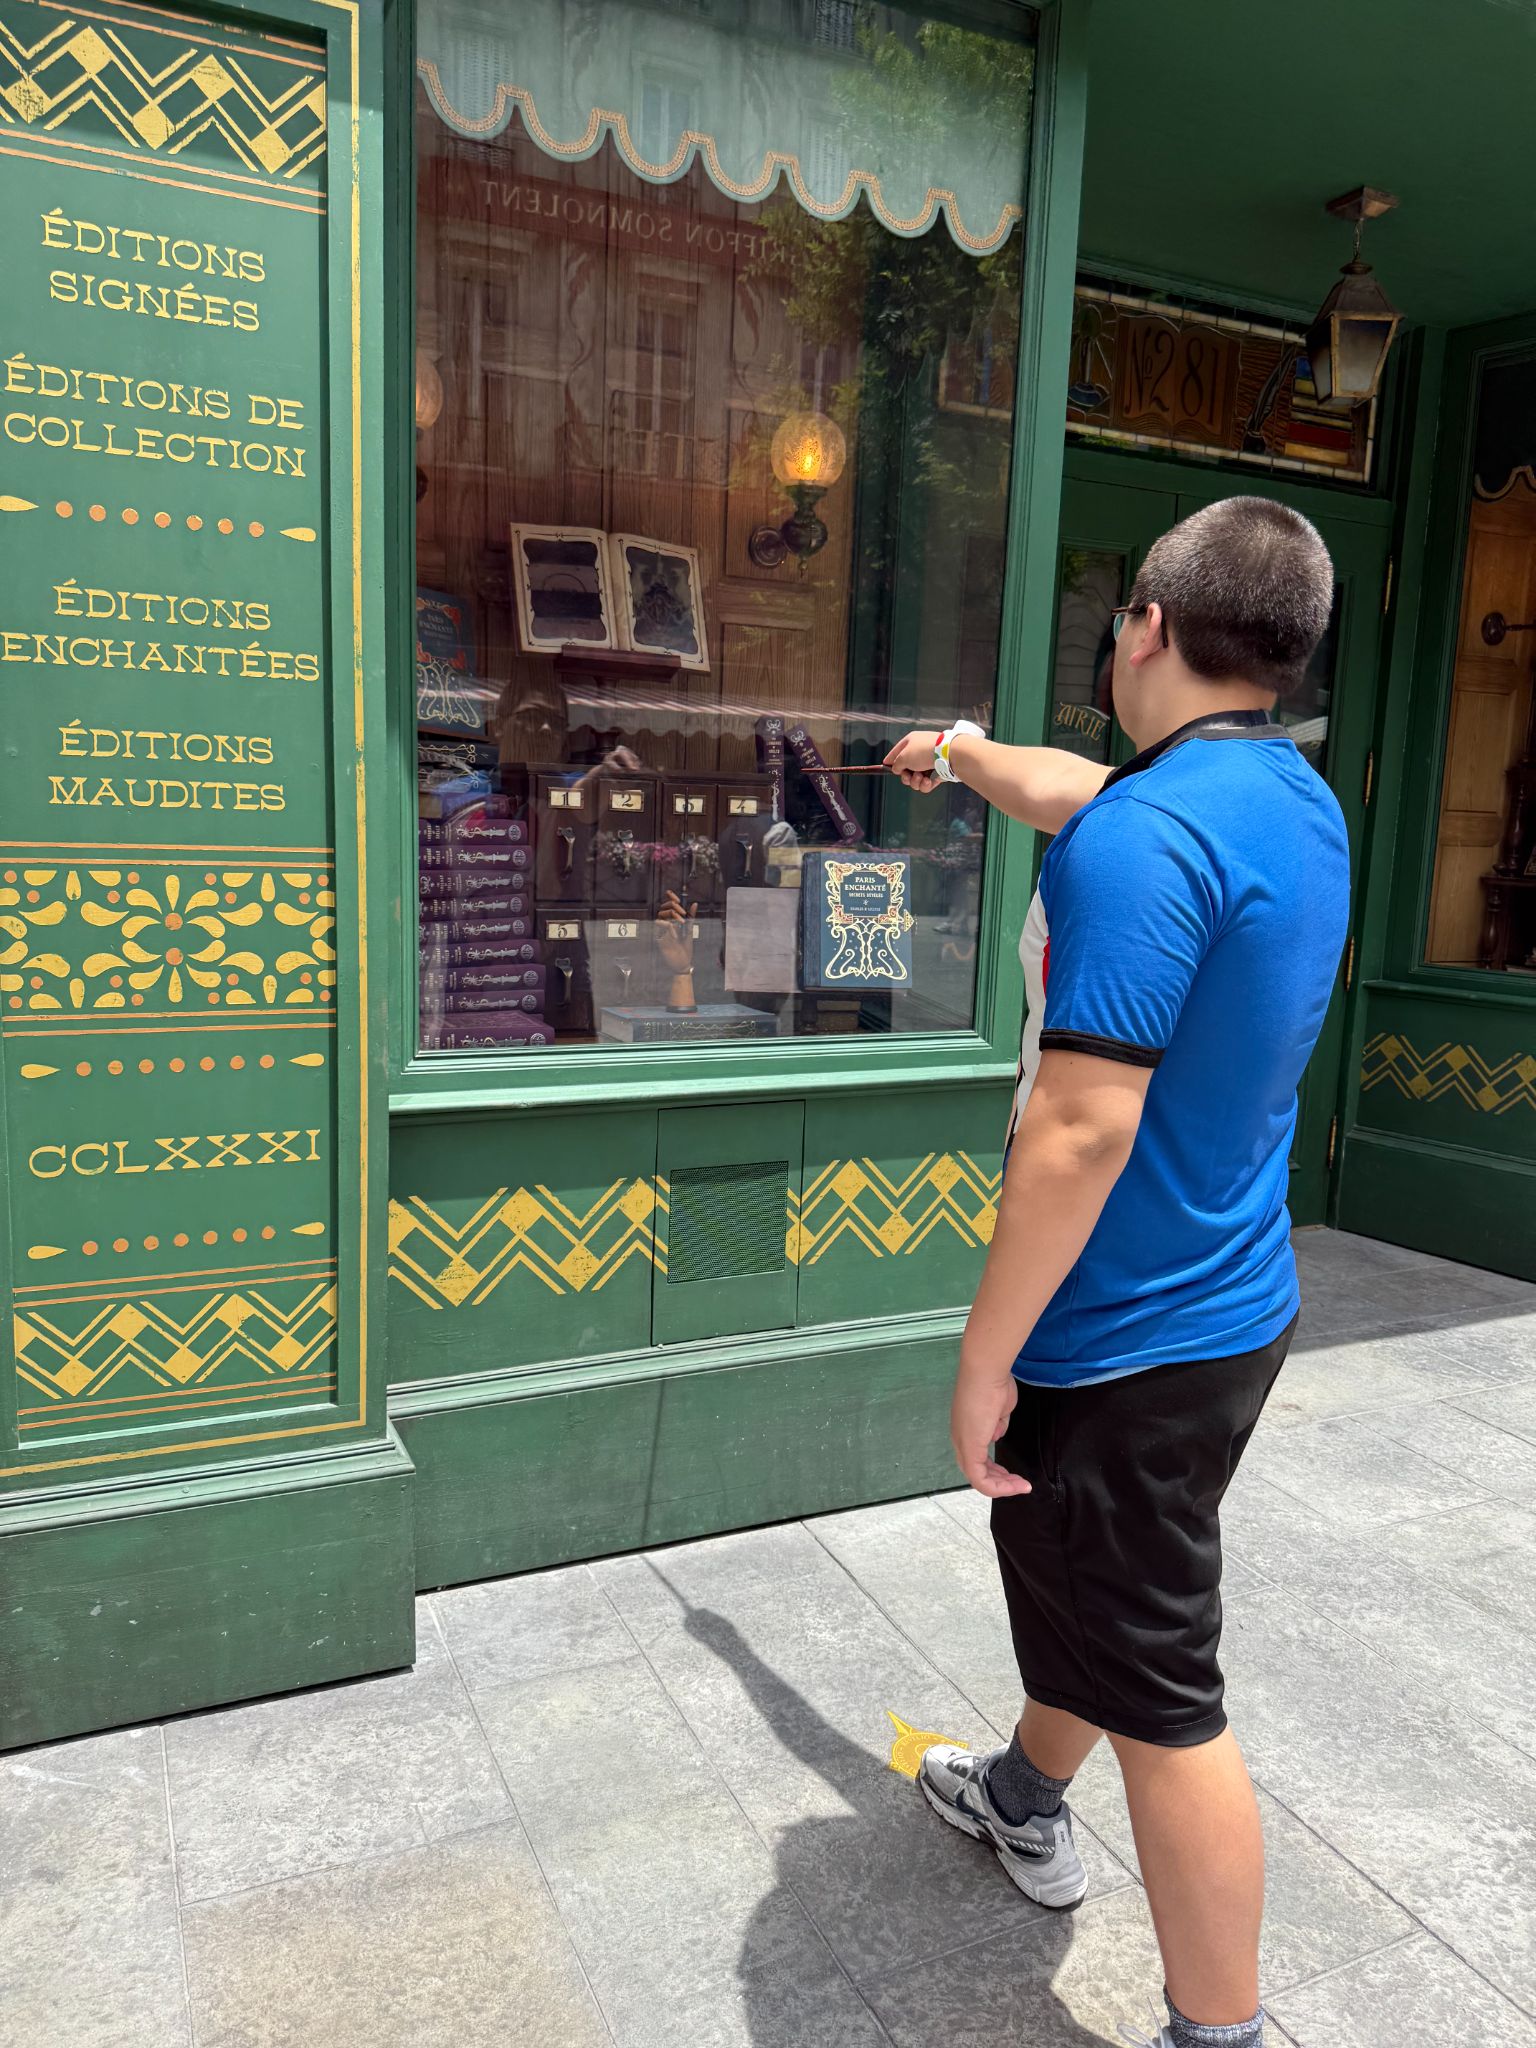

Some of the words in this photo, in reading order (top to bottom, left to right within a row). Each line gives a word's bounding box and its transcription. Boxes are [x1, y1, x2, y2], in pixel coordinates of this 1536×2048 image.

[40, 207, 266, 283] ÉDITIONS
[49, 270, 260, 332] SIGNÉES
[3, 352, 231, 420] ÉDITIONS
[248, 394, 305, 430] DE
[3, 412, 306, 478] COLLECTION
[52, 578, 272, 631] ÉDITIONS
[0, 631, 320, 682] ENCHANTÉES
[58, 718, 274, 765] ÉDITIONS
[48, 775, 286, 811] MAUDITES
[619, 790, 632, 808] 2
[844, 883, 887, 892] ENCHANTÉ
[855, 876, 876, 884] PARIS
[557, 924, 568, 938] 5
[618, 923, 628, 937] 6
[28, 1129, 321, 1179] CCLXXXI
